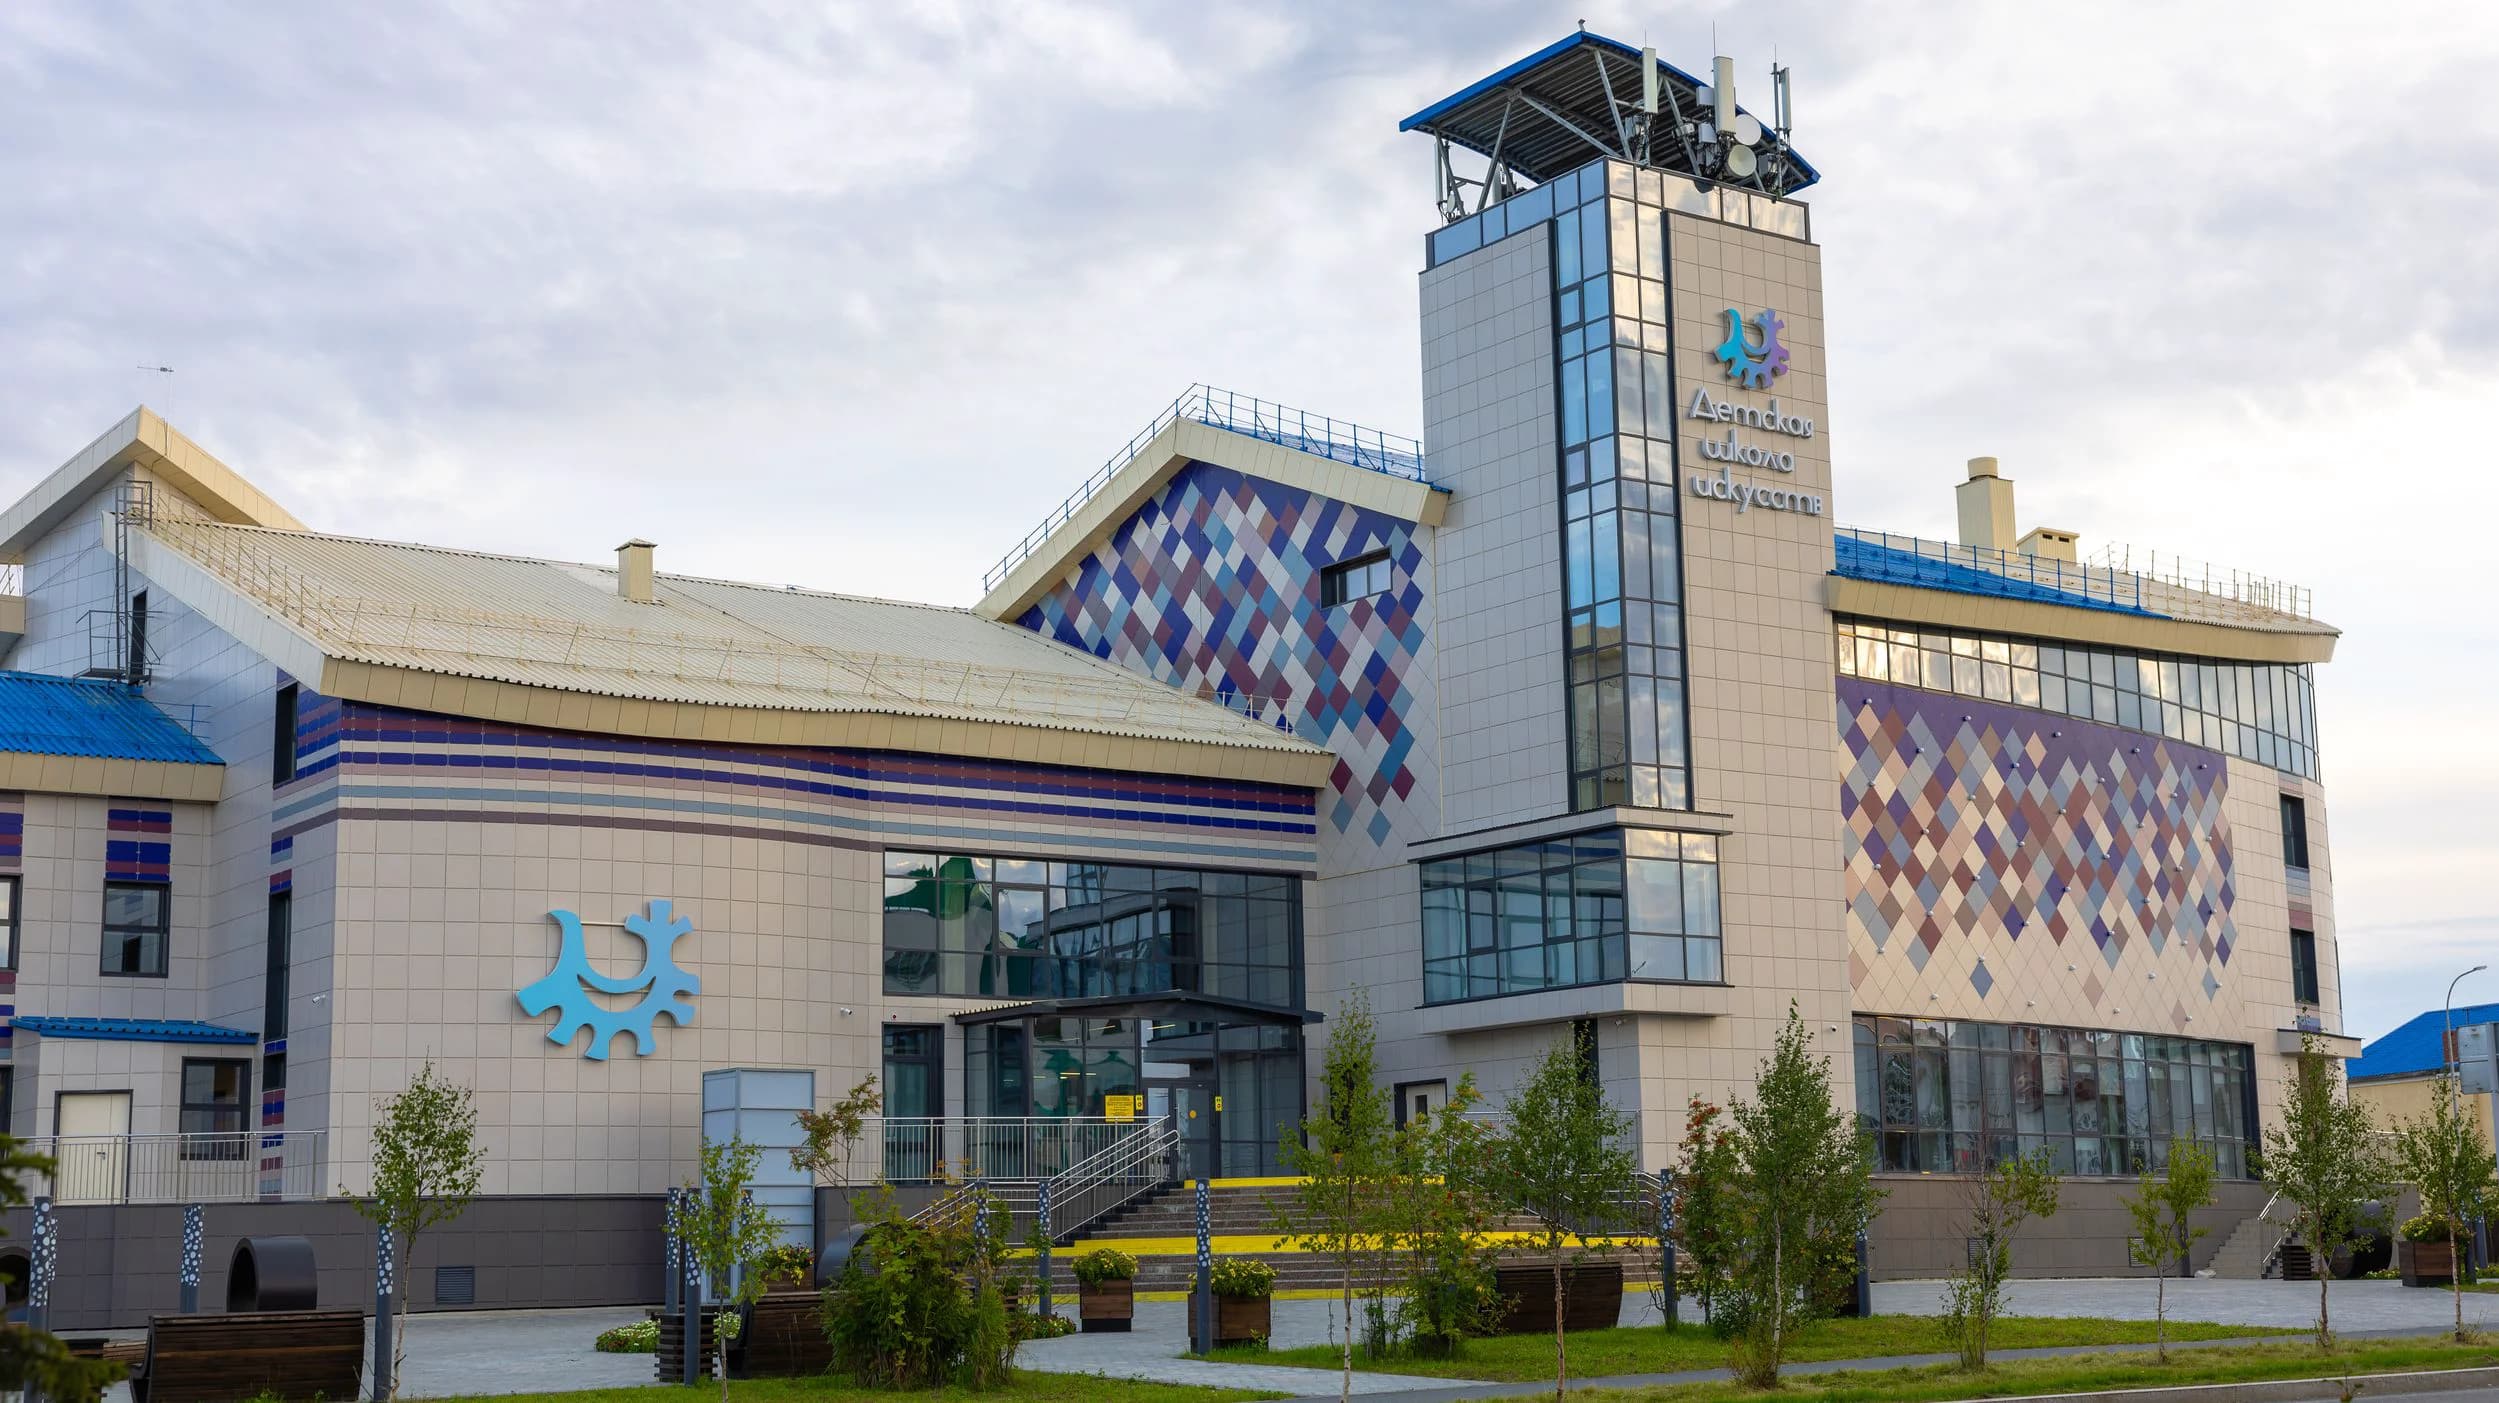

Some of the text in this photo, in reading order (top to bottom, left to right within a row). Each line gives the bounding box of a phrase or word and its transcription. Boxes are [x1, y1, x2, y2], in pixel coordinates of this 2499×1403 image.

[1689, 385, 1814, 438] Детская
[1700, 428, 1794, 473] школа
[1690, 465, 1823, 515] искусств
